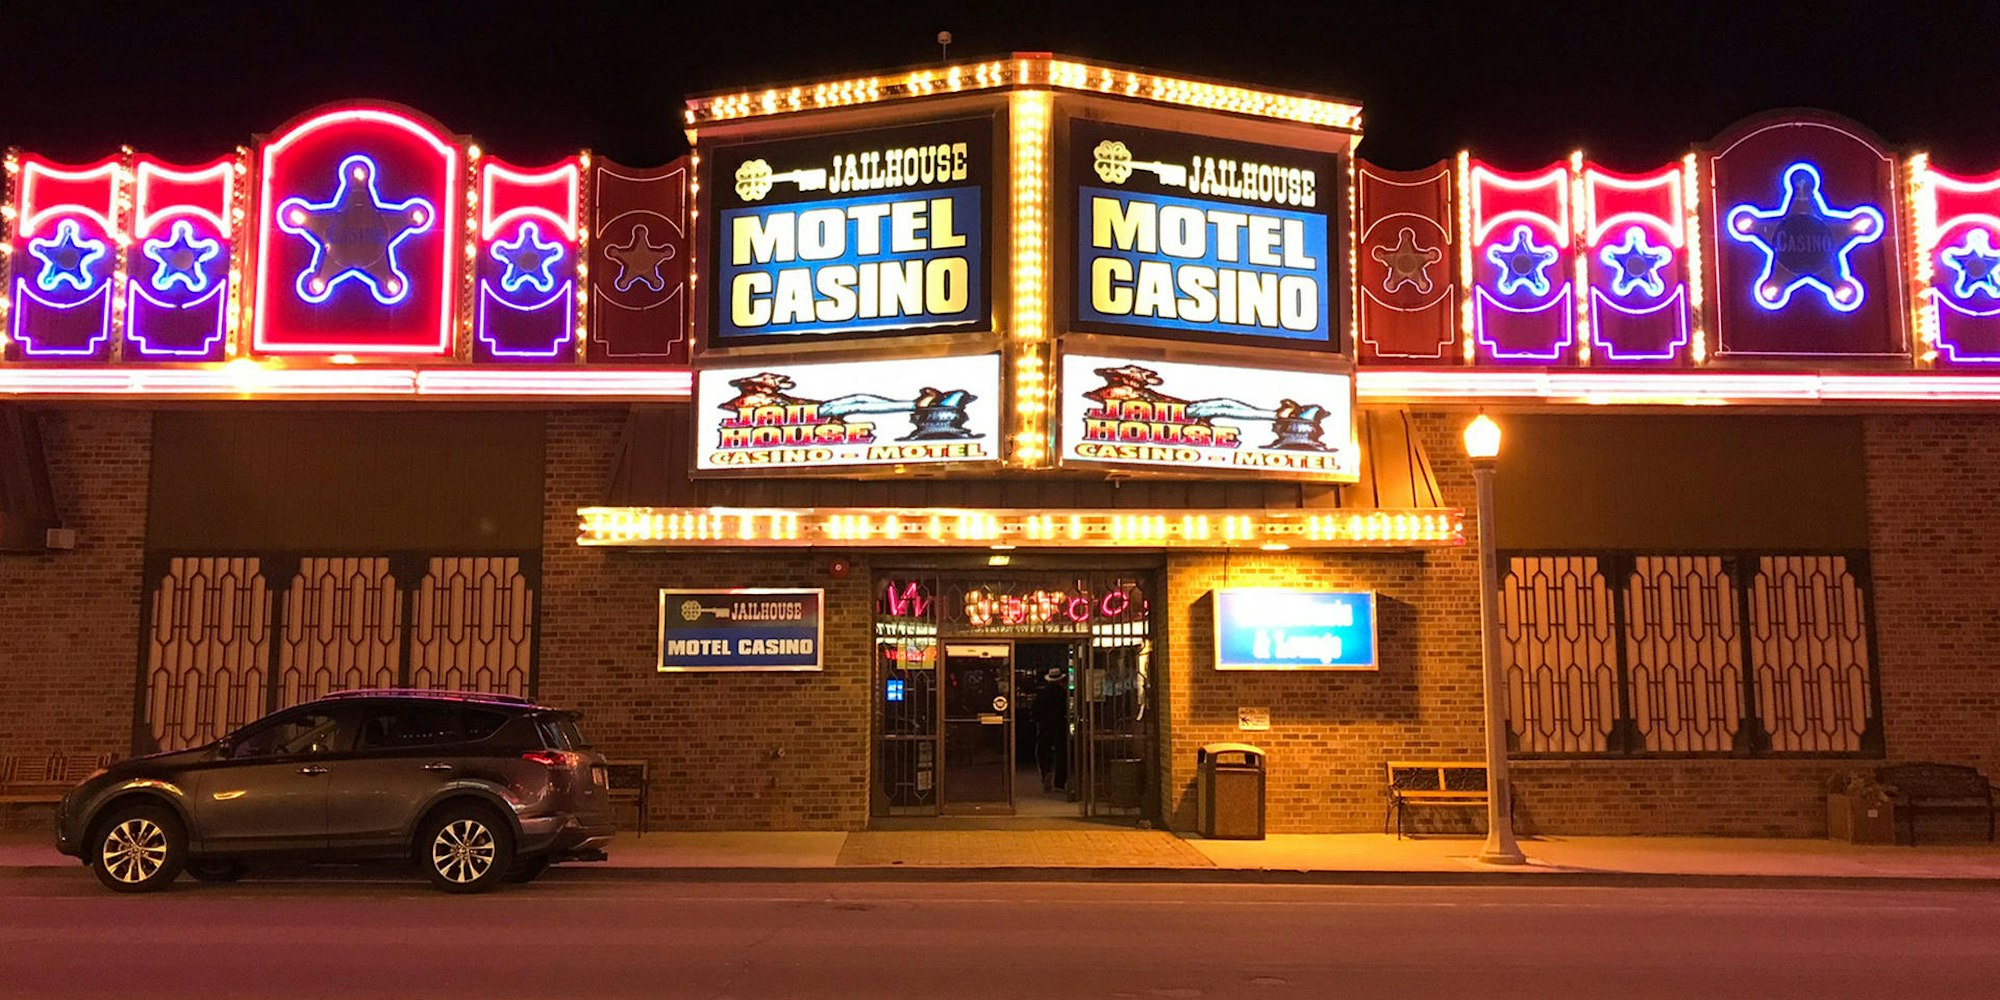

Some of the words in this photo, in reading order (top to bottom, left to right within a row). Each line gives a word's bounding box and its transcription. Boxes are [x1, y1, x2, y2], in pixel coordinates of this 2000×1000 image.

[829, 143, 968, 194] JAILHOUSE
[1188, 155, 1316, 208] JAILHOUSE
[732, 197, 967, 266] MOTEL
[1092, 196, 1317, 271] MOTEL
[731, 256, 970, 328] CASINO
[1091, 256, 1319, 332] CASINO
[720, 402, 830, 428] JAIL
[1085, 398, 1196, 424] JAIL
[717, 421, 877, 449] HOUSE
[1082, 417, 1242, 449] HOUSE
[709, 448, 834, 466] CASINO
[865, 443, 987, 461] MOTEL
[1074, 443, 1202, 463] CASINO
[1232, 450, 1341, 471] MOTEL
[731, 602, 803, 621] JAILHOUSE
[667, 639, 732, 656] MOTEL
[737, 638, 814, 656] CASINO
